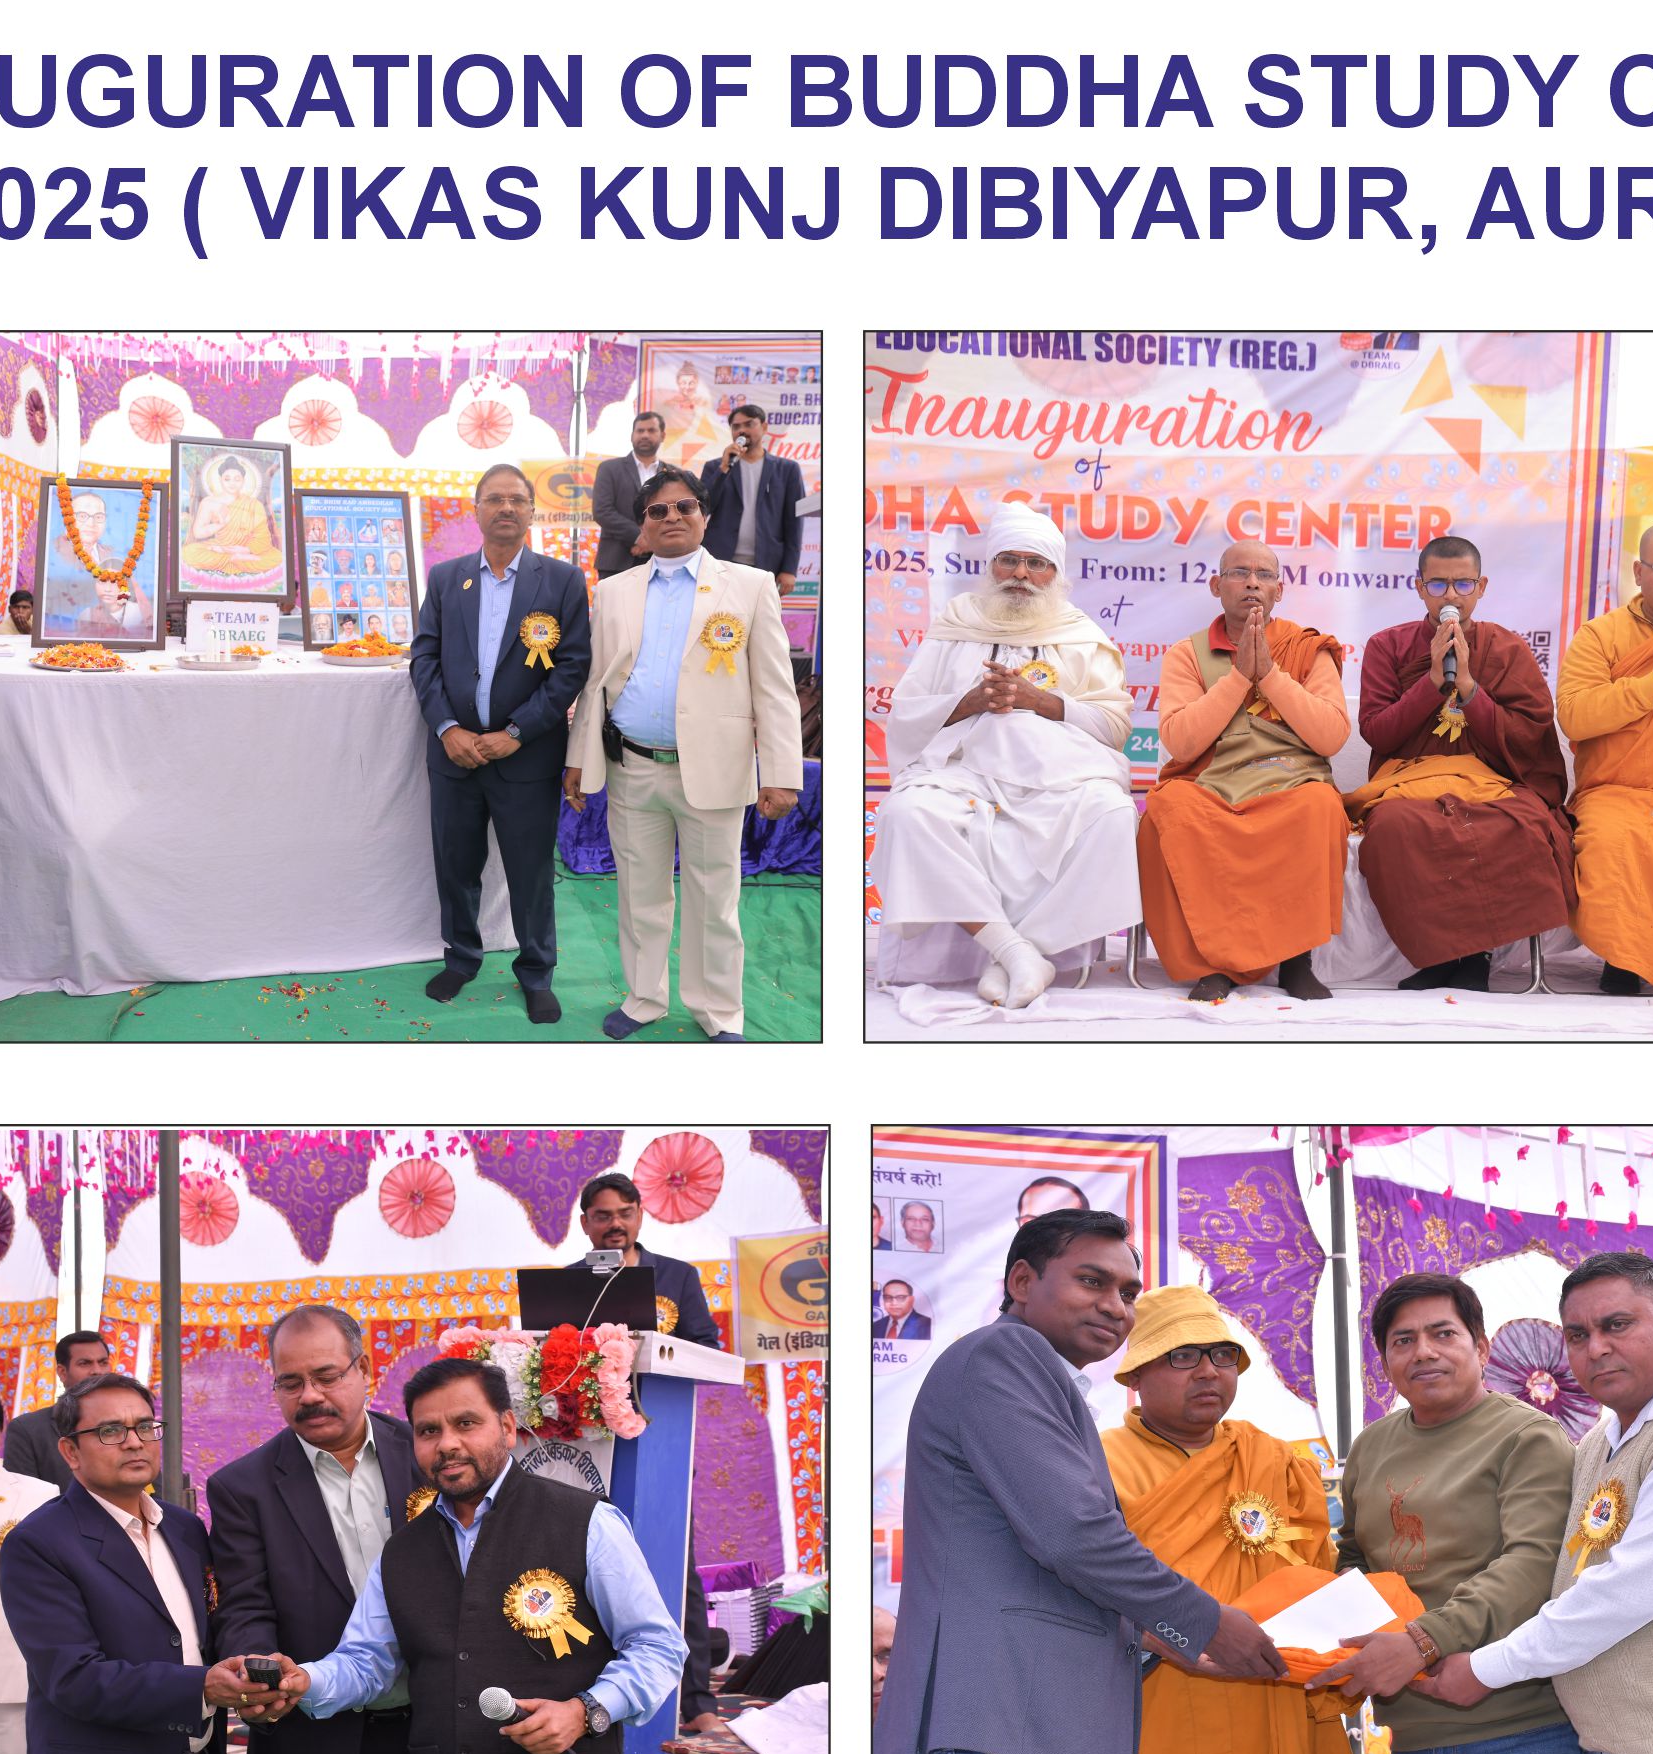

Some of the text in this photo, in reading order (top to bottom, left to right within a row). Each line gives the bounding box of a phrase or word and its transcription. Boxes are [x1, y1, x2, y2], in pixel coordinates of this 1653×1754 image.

[876, 331, 1317, 373] EDUCATIONAL SOCIETY (REG.)
[1361, 361, 1401, 371] DBRAEG
[1362, 351, 1390, 361] TEAM
[865, 364, 1323, 460] Inauguration
[1074, 448, 1111, 491] of
[1226, 497, 1453, 553] CENTER
[1080, 557, 1167, 583] From:
[1318, 566, 1422, 593] onward
[215, 612, 256, 624] TEAM
[1099, 596, 1134, 627] at
